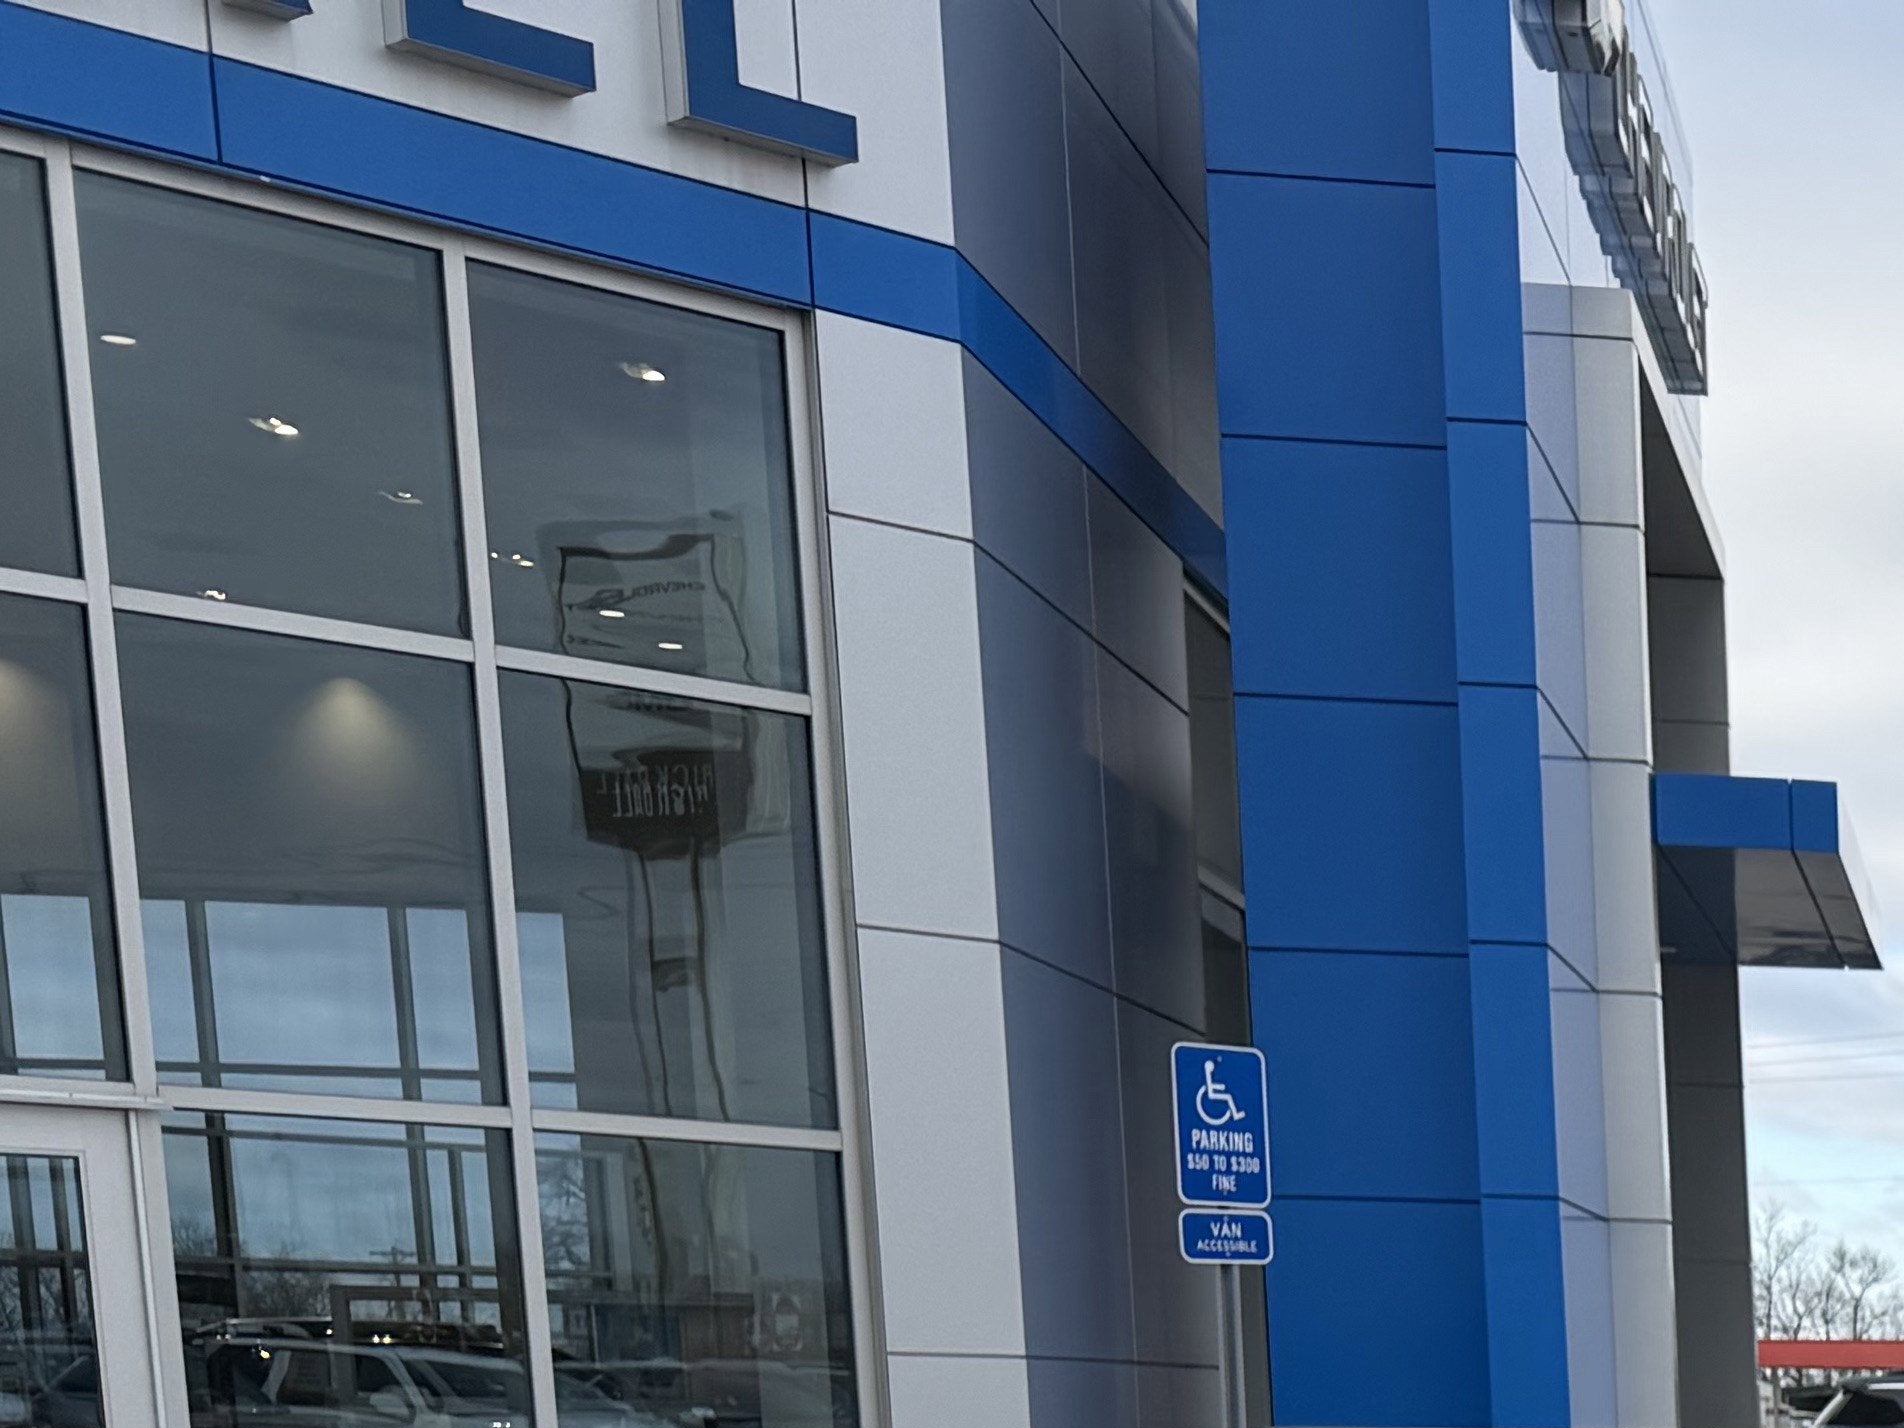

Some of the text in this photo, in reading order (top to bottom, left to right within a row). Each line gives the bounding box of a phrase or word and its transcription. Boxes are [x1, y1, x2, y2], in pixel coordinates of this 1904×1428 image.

[1191, 1129, 1254, 1153] PARKING
[1213, 1155, 1227, 1172] TO
[1212, 1174, 1237, 1192] FINE
[1210, 1221, 1242, 1239] VAN
[1196, 1239, 1258, 1254] ACCESSIBLE
